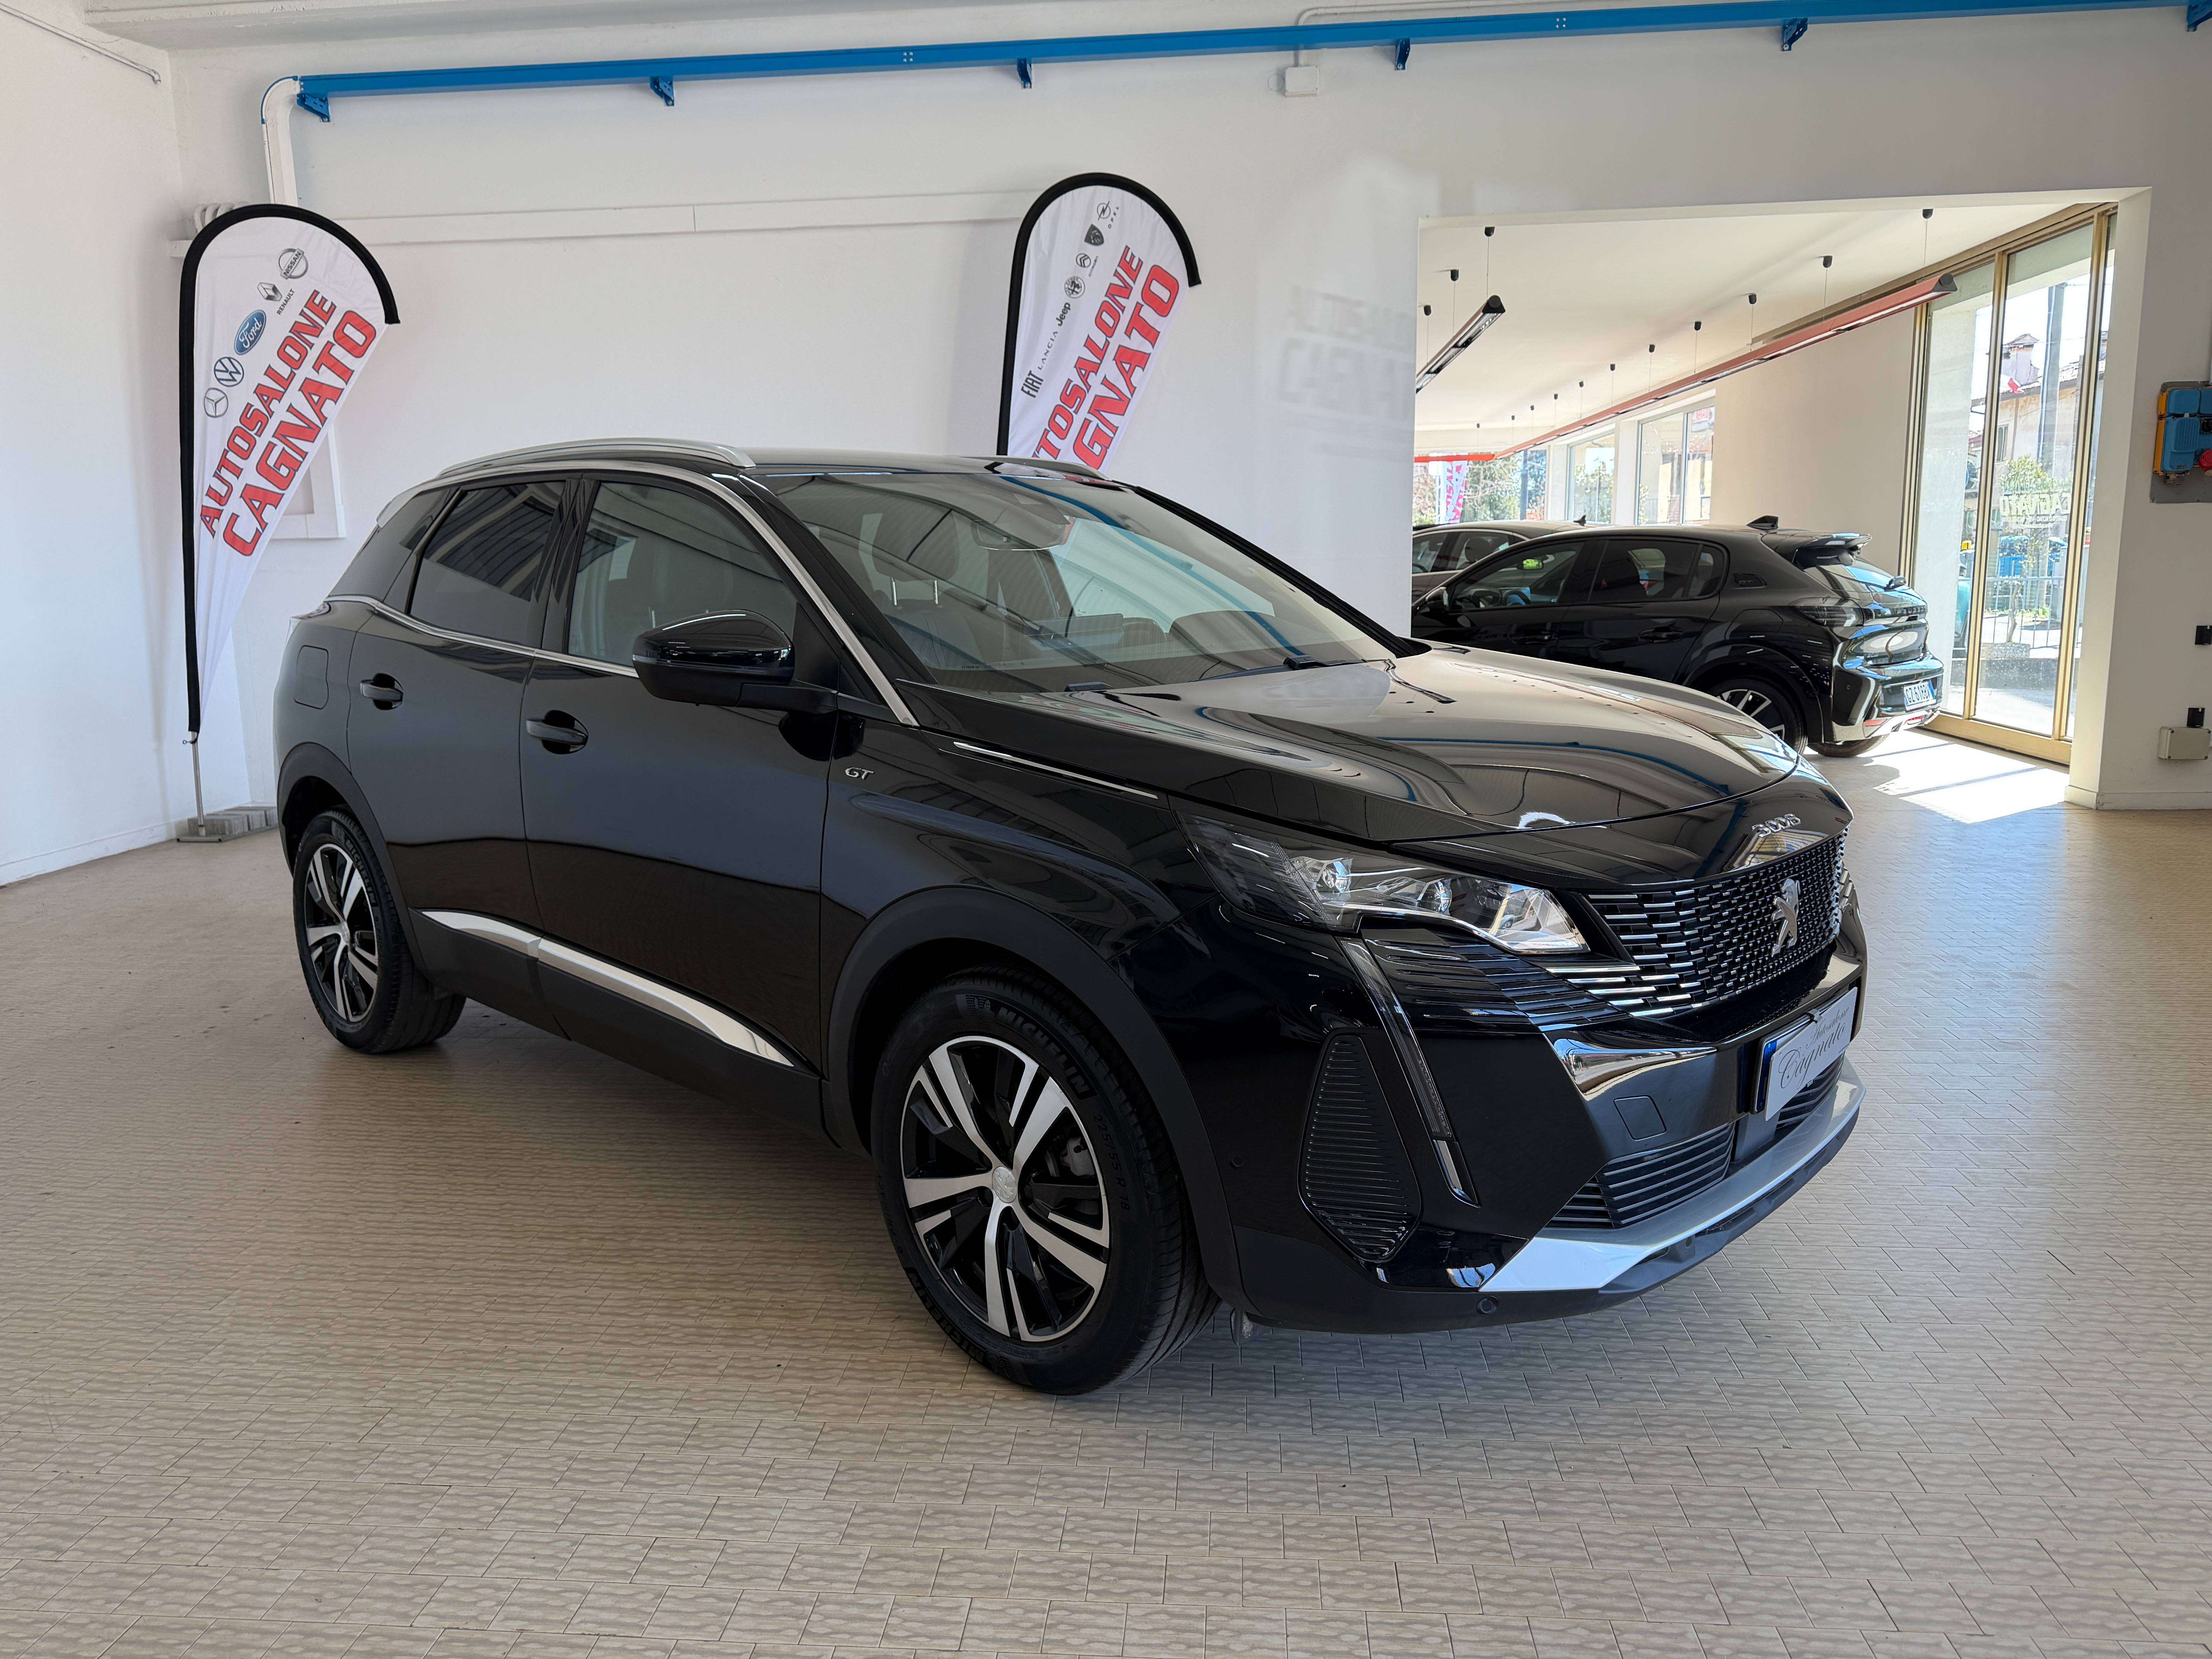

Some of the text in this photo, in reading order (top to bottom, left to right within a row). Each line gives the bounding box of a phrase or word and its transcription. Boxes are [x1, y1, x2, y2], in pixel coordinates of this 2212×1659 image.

[1108, 206, 1120, 229] OPEL
[283, 251, 302, 278] NISSAN
[276, 288, 295, 315] RENAULT
[1057, 302, 1071, 326] Jeep
[238, 318, 262, 349] Ford
[1032, 245, 1144, 460] TOSALONE
[1021, 370, 1044, 398] FIAT
[200, 289, 337, 539] AUTOSALONE
[223, 311, 376, 556] CAGNATO
[845, 766, 874, 780] GT
[1751, 813, 1801, 838] 3008
[997, 1006, 1091, 1094] MICHELIN
[1092, 1114, 1130, 1211] 225/55 R 18
